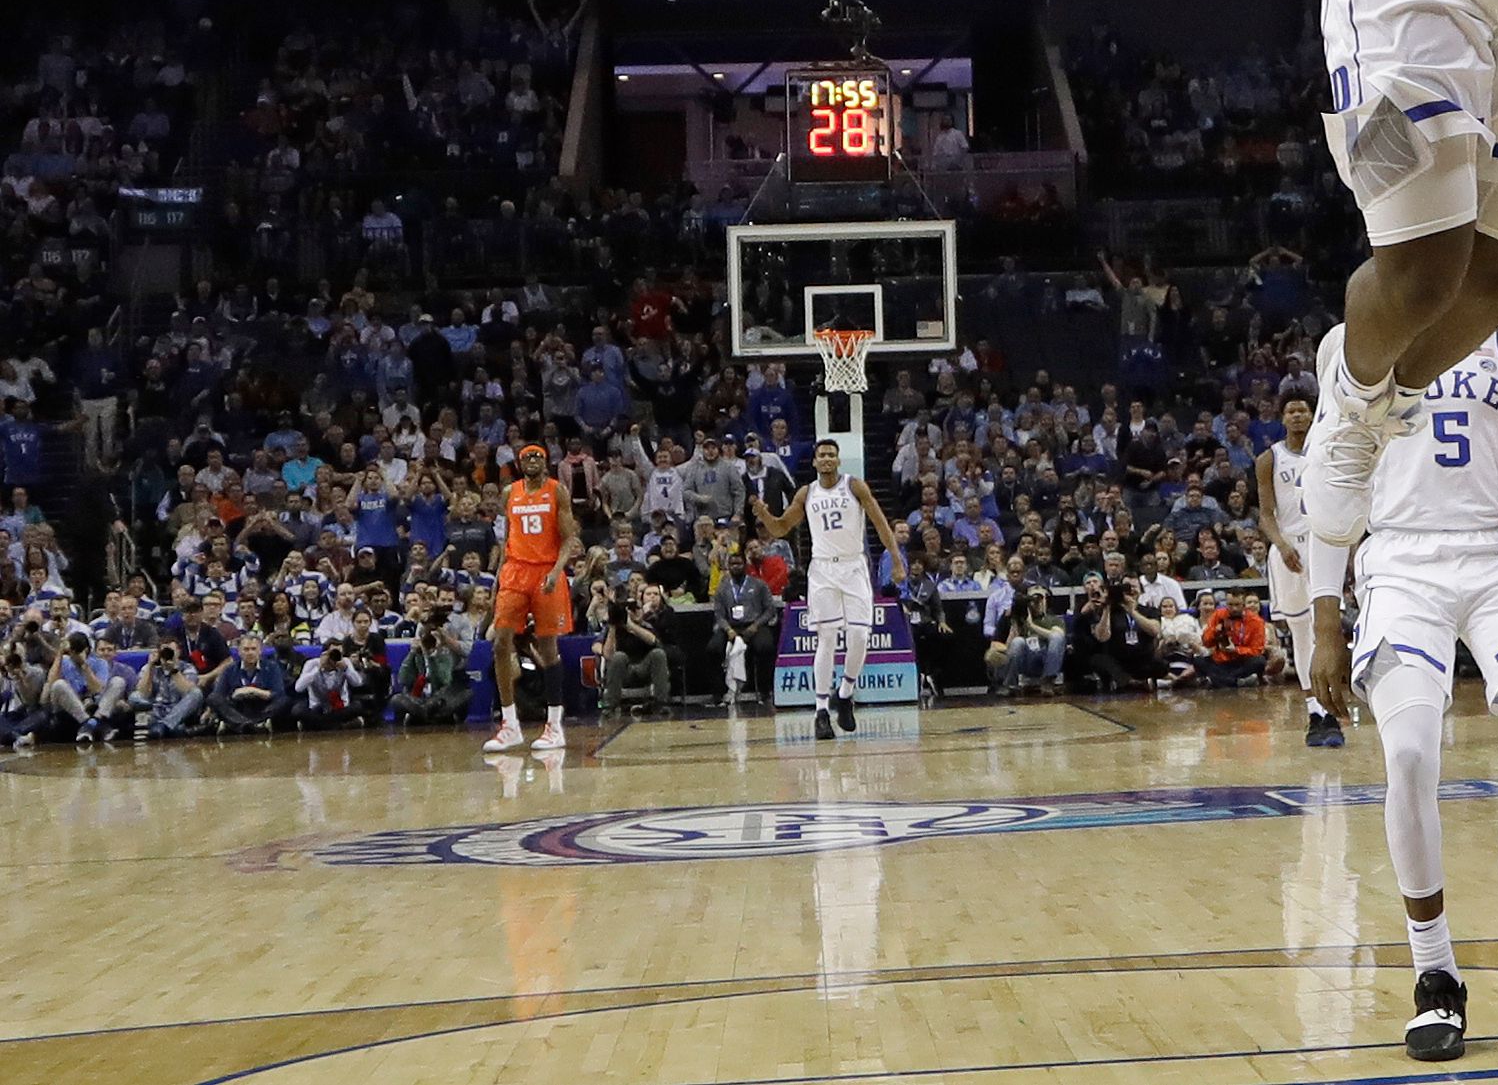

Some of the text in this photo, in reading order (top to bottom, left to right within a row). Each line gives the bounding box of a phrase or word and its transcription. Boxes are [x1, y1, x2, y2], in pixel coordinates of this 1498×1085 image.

[810, 80, 877, 107] 17:55
[808, 107, 875, 155] 28
[1432, 411, 1471, 468] 5
[811, 497, 850, 513] DUKE
[521, 514, 543, 535] 13
[821, 511, 843, 531] 12
[793, 629, 892, 652] THECCOM
[781, 671, 904, 692] #AURNEY
